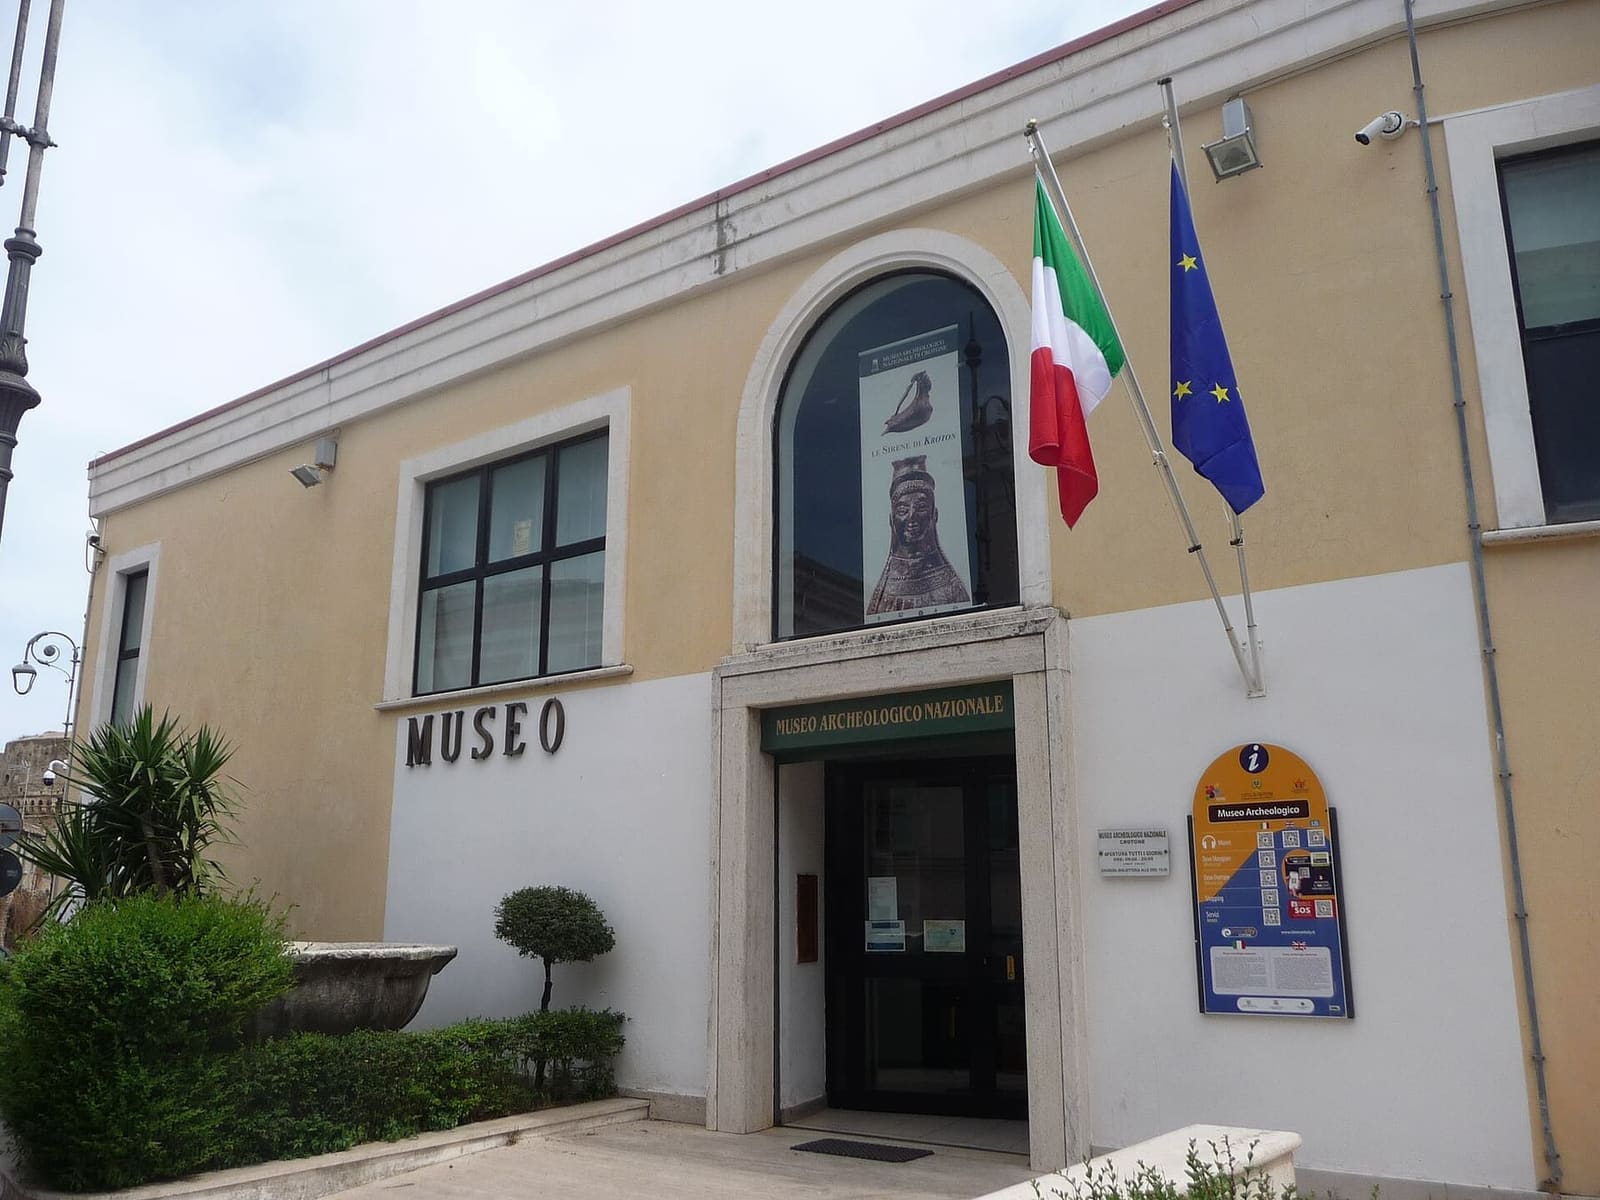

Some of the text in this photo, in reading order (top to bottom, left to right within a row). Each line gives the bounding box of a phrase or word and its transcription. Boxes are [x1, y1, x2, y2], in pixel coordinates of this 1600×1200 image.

[882, 443, 911, 455] SIRENE
[924, 432, 957, 446] KROTON
[776, 695, 1004, 737] MUSEO ARCHEOLOGICO NAZIONALE
[405, 697, 566, 767] MUSEO
[1217, 805, 1301, 818] Museo Archeologico
[1294, 906, 1311, 914] SOS
